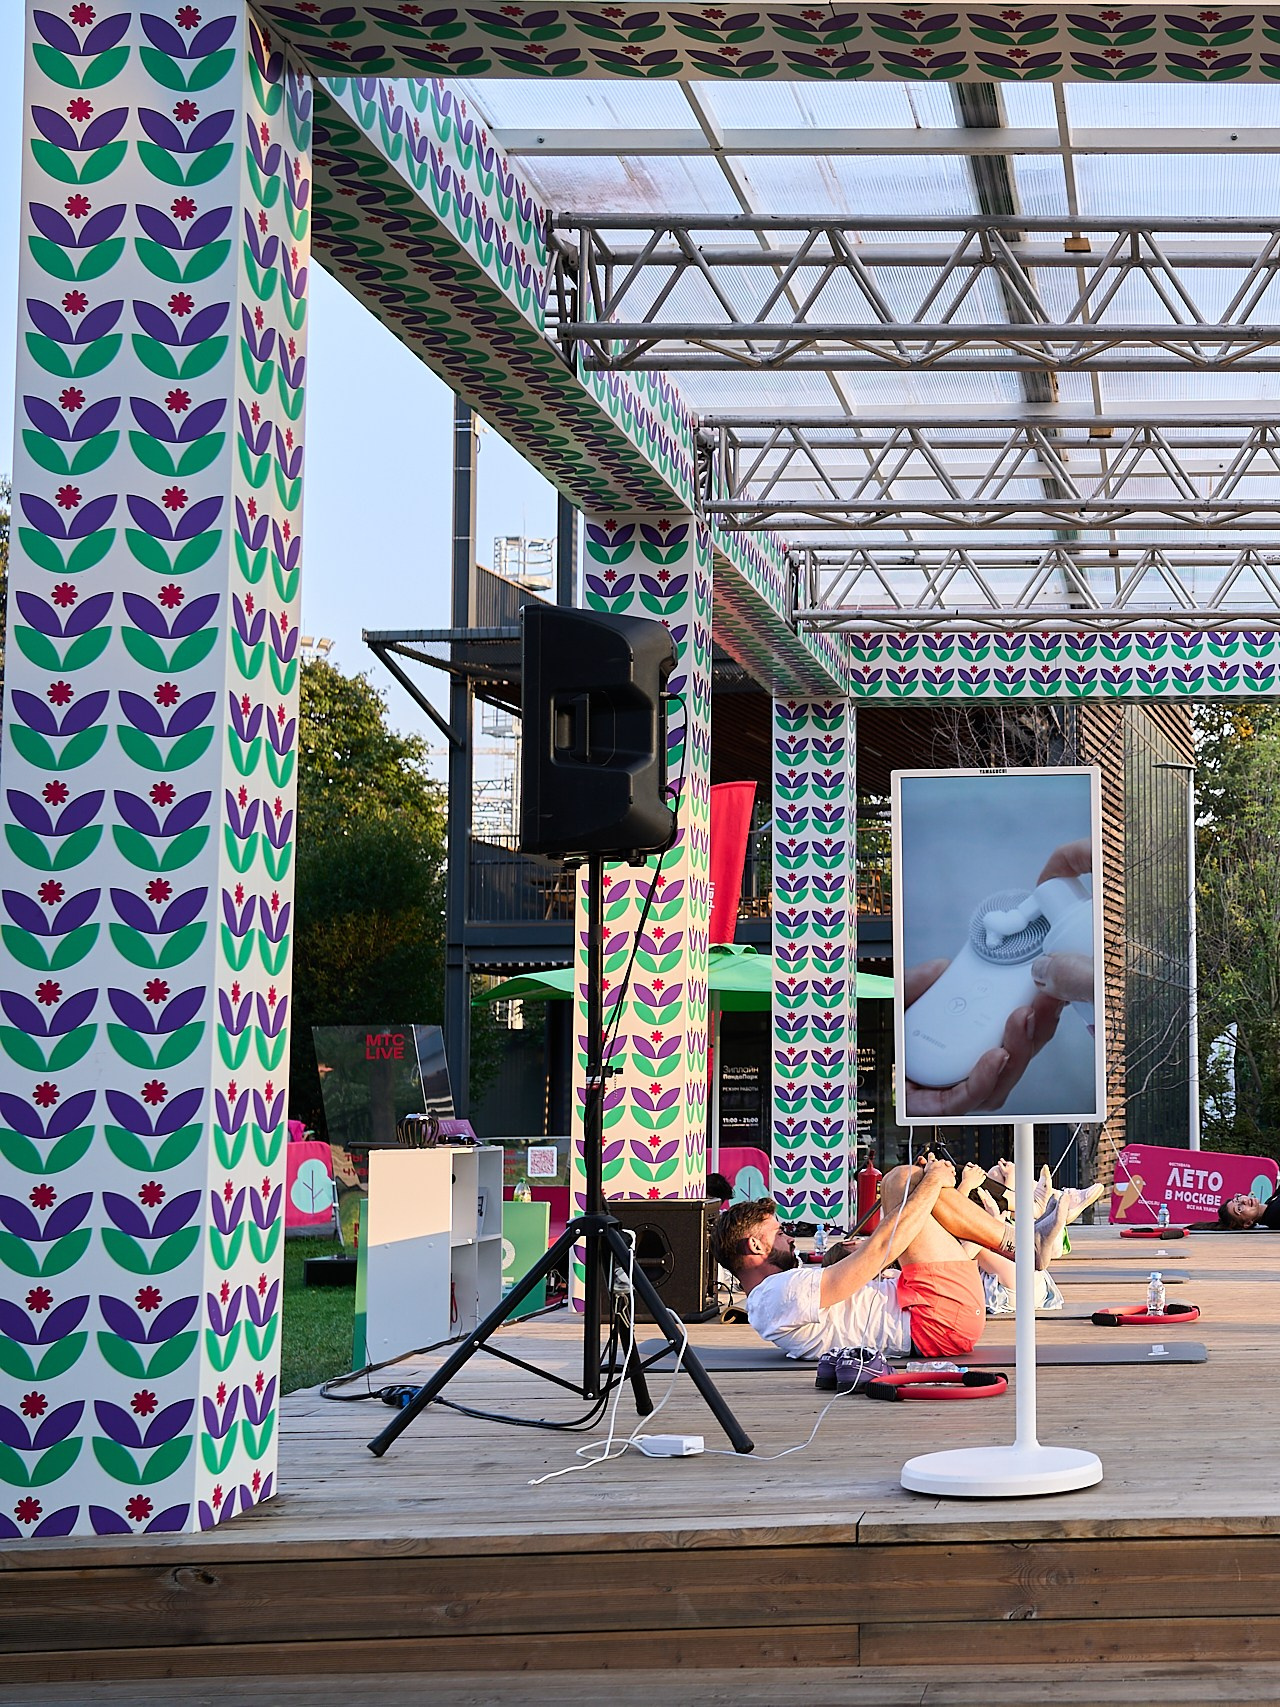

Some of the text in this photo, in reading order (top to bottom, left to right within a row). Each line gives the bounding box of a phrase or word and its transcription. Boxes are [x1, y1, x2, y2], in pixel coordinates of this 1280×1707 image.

[365, 1047, 405, 1060] LIVE
[1166, 1167, 1223, 1192] ЛЕТО
[1165, 1189, 1222, 1206] В МОСКВЕ
